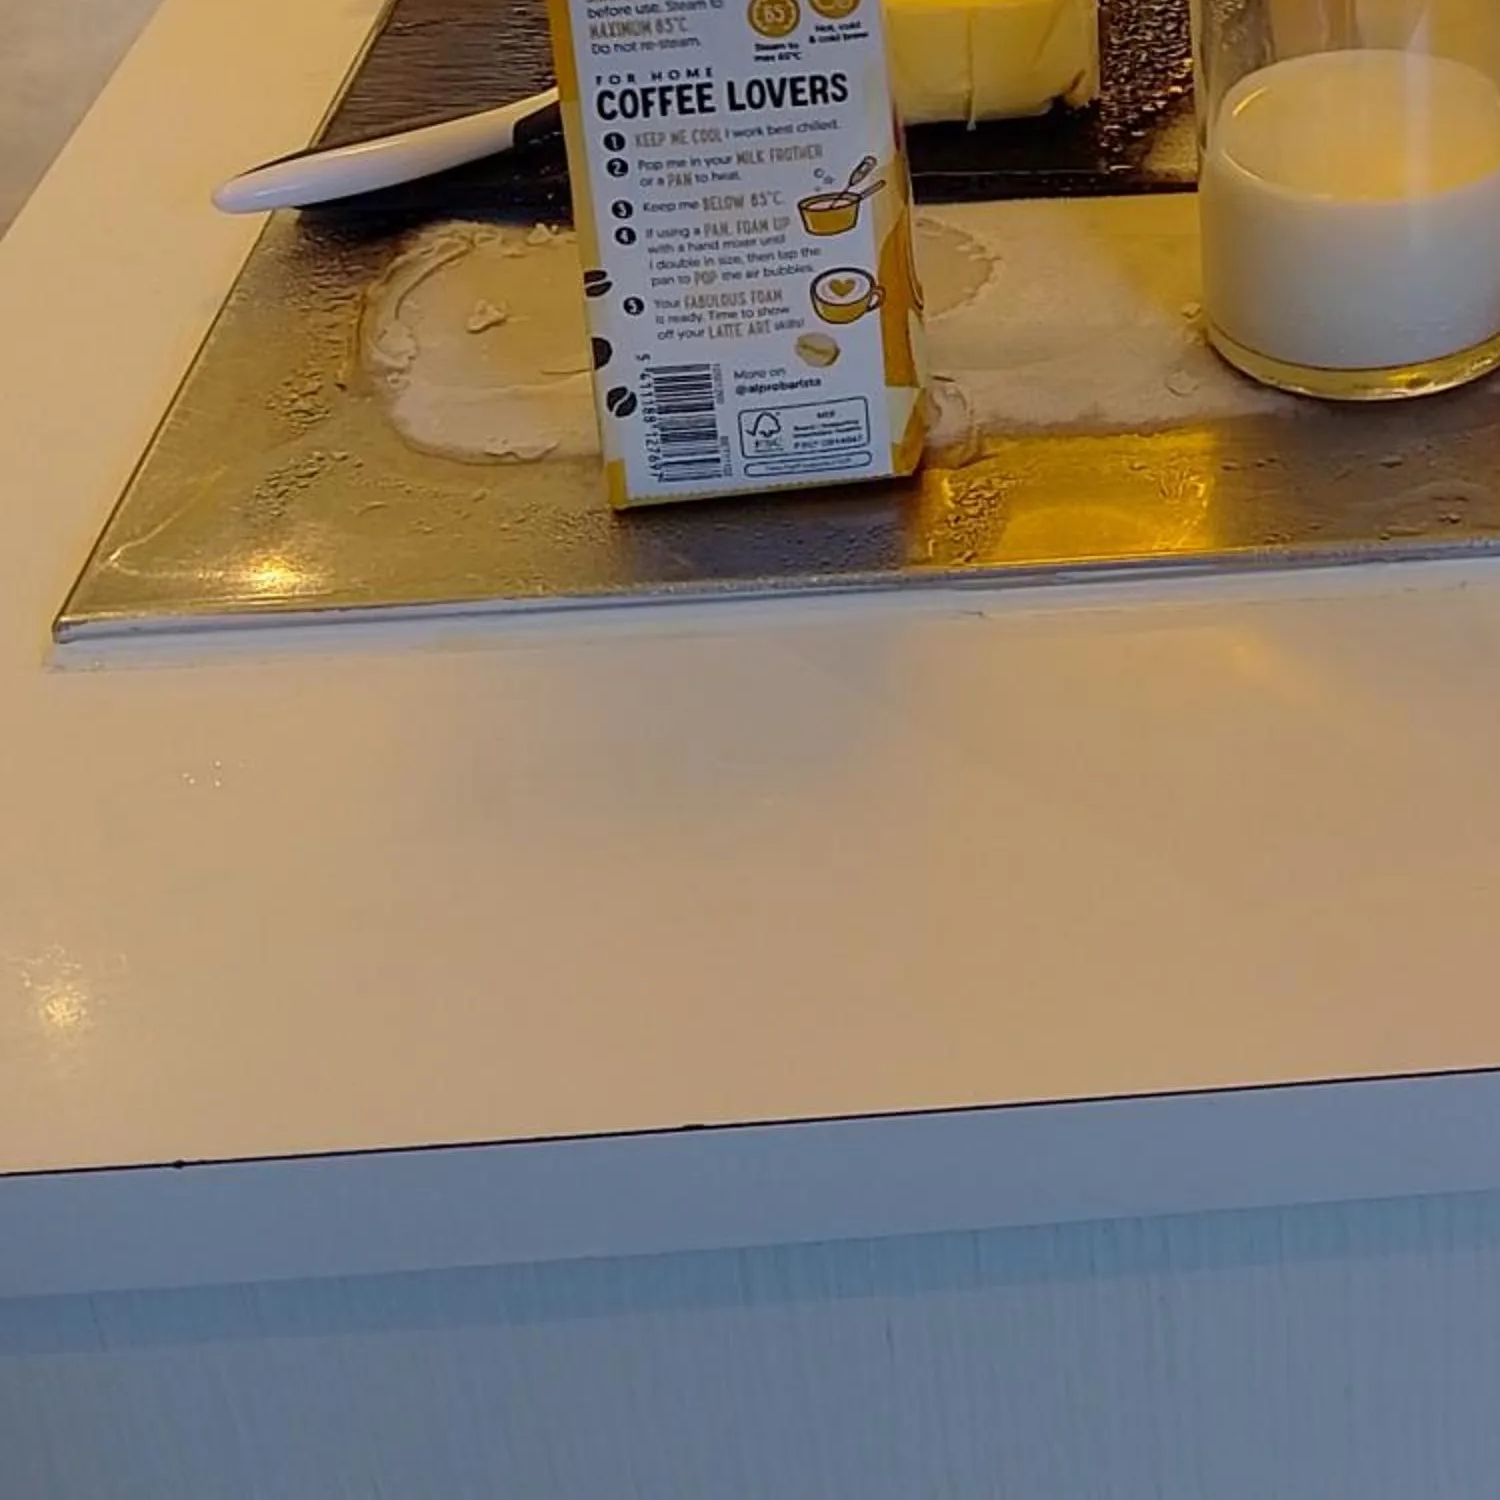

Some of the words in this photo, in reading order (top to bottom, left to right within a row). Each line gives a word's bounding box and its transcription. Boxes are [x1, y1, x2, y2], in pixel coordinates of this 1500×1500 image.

[587, 4, 632, 19] before
[665, 0, 707, 12] Steam
[589, 20, 652, 38] MAXIMUM
[592, 43, 610, 55] Do
[614, 41, 636, 52] not
[595, 74, 636, 85] FOR
[652, 68, 713, 82] HOME
[597, 82, 716, 120] COFFEE
[727, 73, 848, 112] LOVERS
[635, 132, 666, 147] KEEP
[671, 132, 688, 145] ME
[692, 129, 722, 144] COOL
[732, 126, 764, 138] work
[767, 124, 793, 136] best
[638, 160, 664, 172] Pop
[667, 159, 687, 168] me
[691, 156, 702, 167] in
[704, 155, 733, 169] your
[737, 149, 764, 165] MILK
[770, 144, 823, 163] FROTHER
[640, 178, 653, 188] or
[668, 173, 692, 188] PAN
[695, 172, 708, 184] to
[643, 202, 678, 214] Keep
[681, 201, 699, 210] me
[702, 194, 745, 212] BELOW
[656, 228, 690, 239] using
[737, 219, 768, 234] FOAM
[773, 217, 791, 231] UP
[648, 244, 675, 253] with
[688, 241, 719, 252] hand
[722, 238, 757, 249] mixer
[760, 234, 786, 246] until
[656, 257, 700, 270] double
[704, 256, 715, 266] in
[747, 251, 775, 263] then
[777, 249, 798, 261] tap
[801, 247, 822, 257] the
[651, 276, 675, 287] pan
[677, 274, 691, 285] to
[694, 270, 719, 285] POP
[721, 269, 742, 281] the
[653, 299, 681, 309] Your
[684, 293, 748, 309] FABULOUS
[751, 289, 782, 304] FOAM
[707, 309, 738, 320] Time
[741, 308, 755, 318] to
[758, 306, 790, 316] show
[657, 330, 674, 340] off
[677, 328, 704, 341] your
[708, 324, 745, 340] LATTE
[748, 321, 771, 336] ART
[733, 370, 767, 380] More
[770, 368, 786, 379] on
[735, 378, 821, 396] @alprobarista
